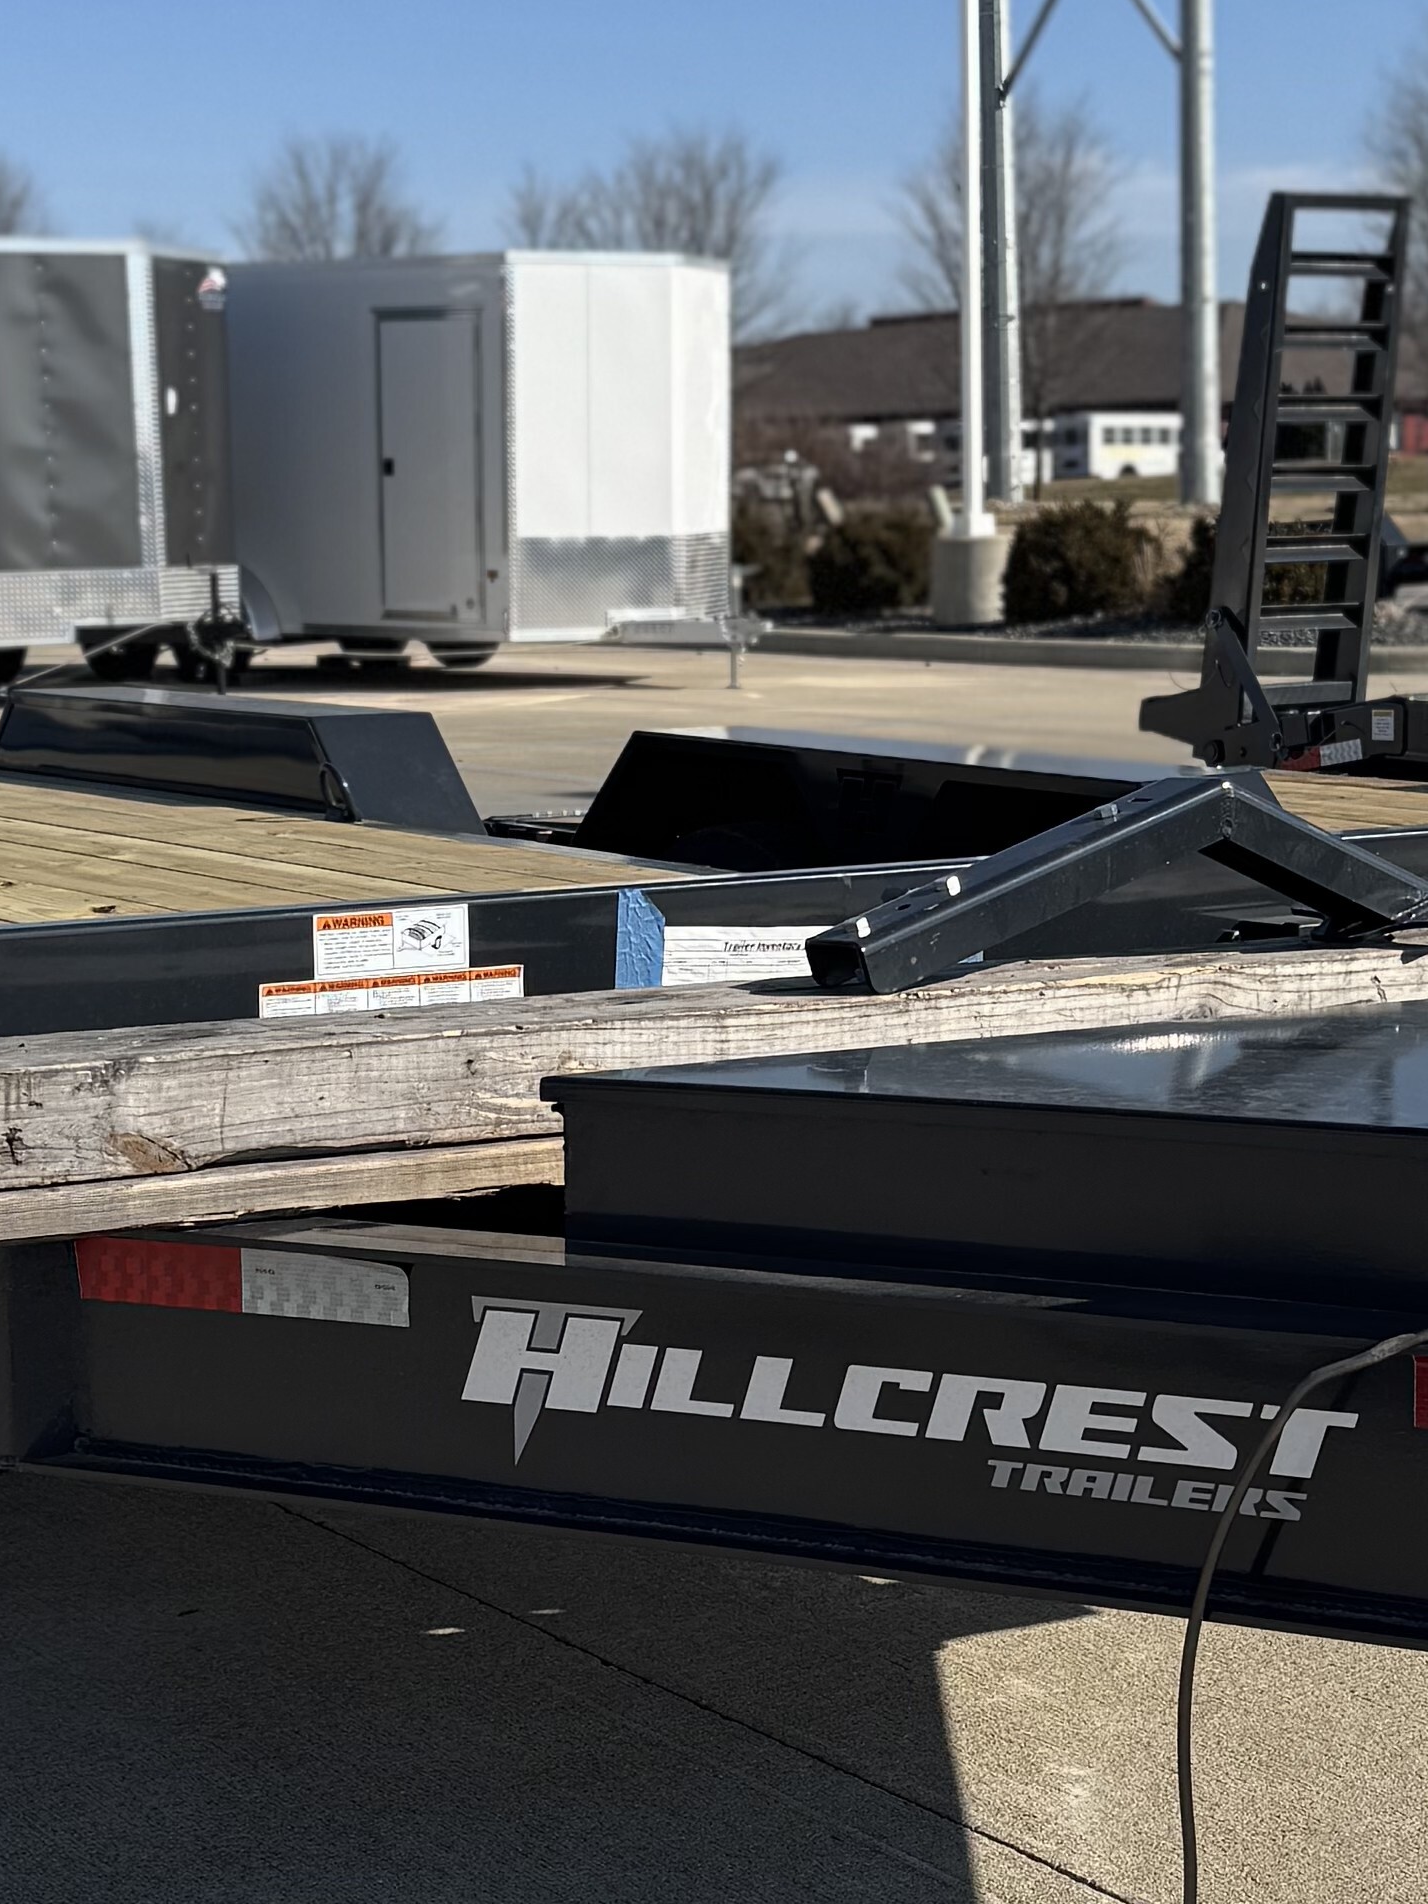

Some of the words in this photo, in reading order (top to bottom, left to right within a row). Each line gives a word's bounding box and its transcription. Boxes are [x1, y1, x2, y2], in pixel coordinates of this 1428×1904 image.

[332, 916, 385, 929] WARNING
[461, 1296, 1359, 1479] HILLCREST
[987, 1459, 1308, 1522] TRAILERS
